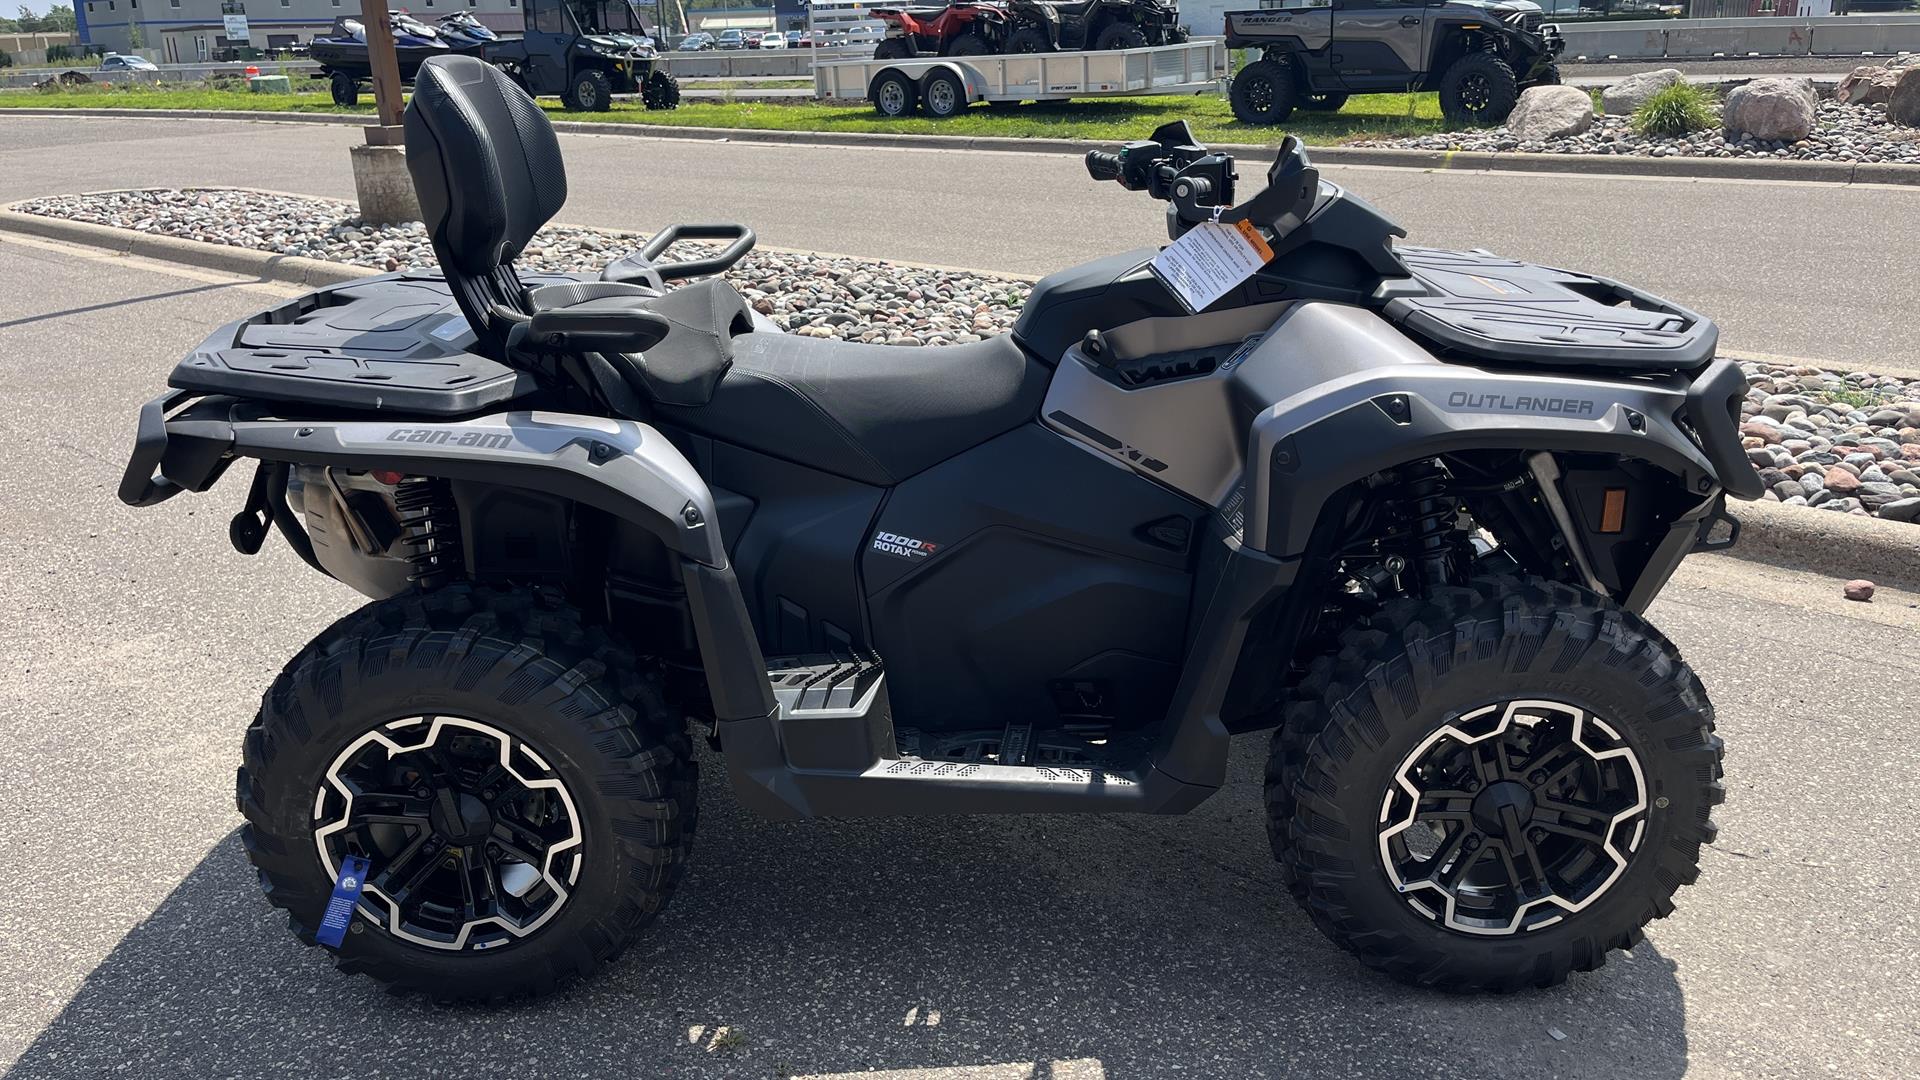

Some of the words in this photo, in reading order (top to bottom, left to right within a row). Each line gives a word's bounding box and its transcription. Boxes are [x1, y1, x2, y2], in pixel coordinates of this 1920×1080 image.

[1448, 391, 1593, 415] OUTLANDER
[386, 428, 513, 449] can-am
[873, 540, 912, 557] ROTAX
[876, 531, 936, 552] 1000R
